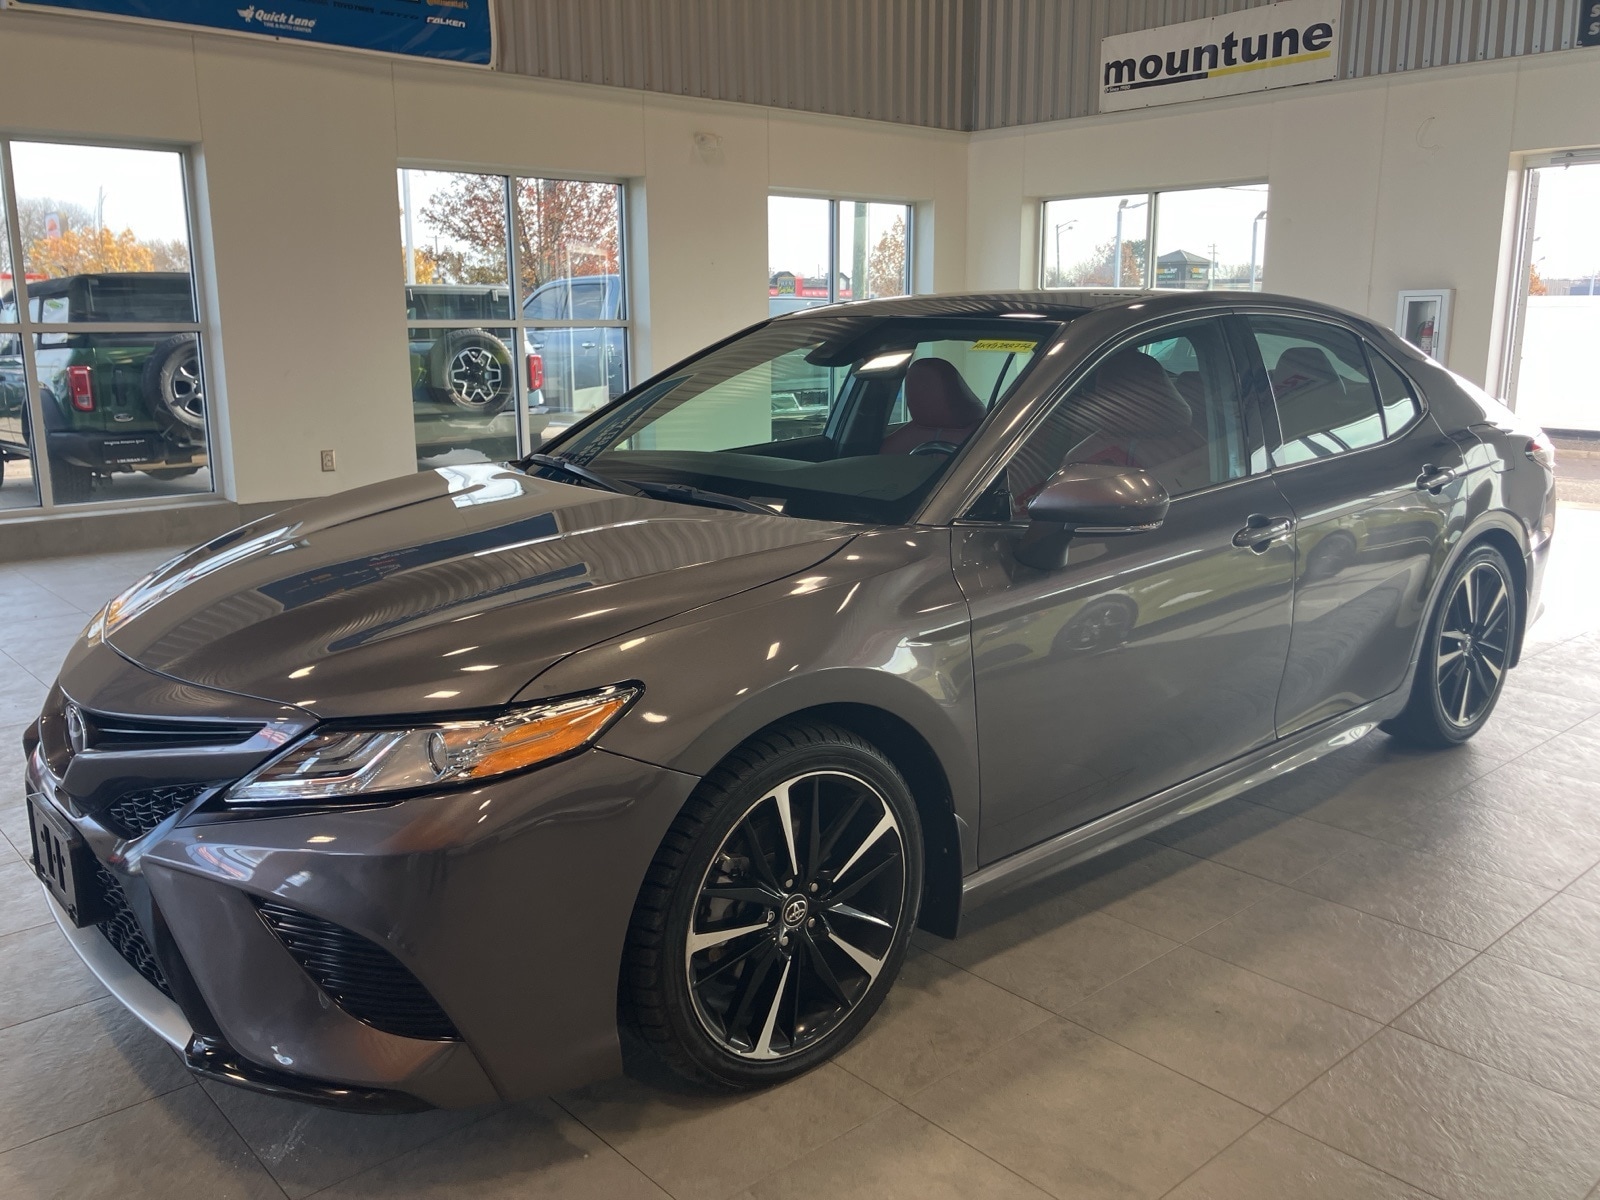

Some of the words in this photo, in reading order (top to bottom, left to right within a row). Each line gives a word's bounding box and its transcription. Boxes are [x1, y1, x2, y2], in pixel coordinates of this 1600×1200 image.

[255, 9, 287, 24] Quick
[288, 14, 316, 28] Lane
[427, 16, 466, 28] FALKEN
[1104, 22, 1333, 86] mountune
